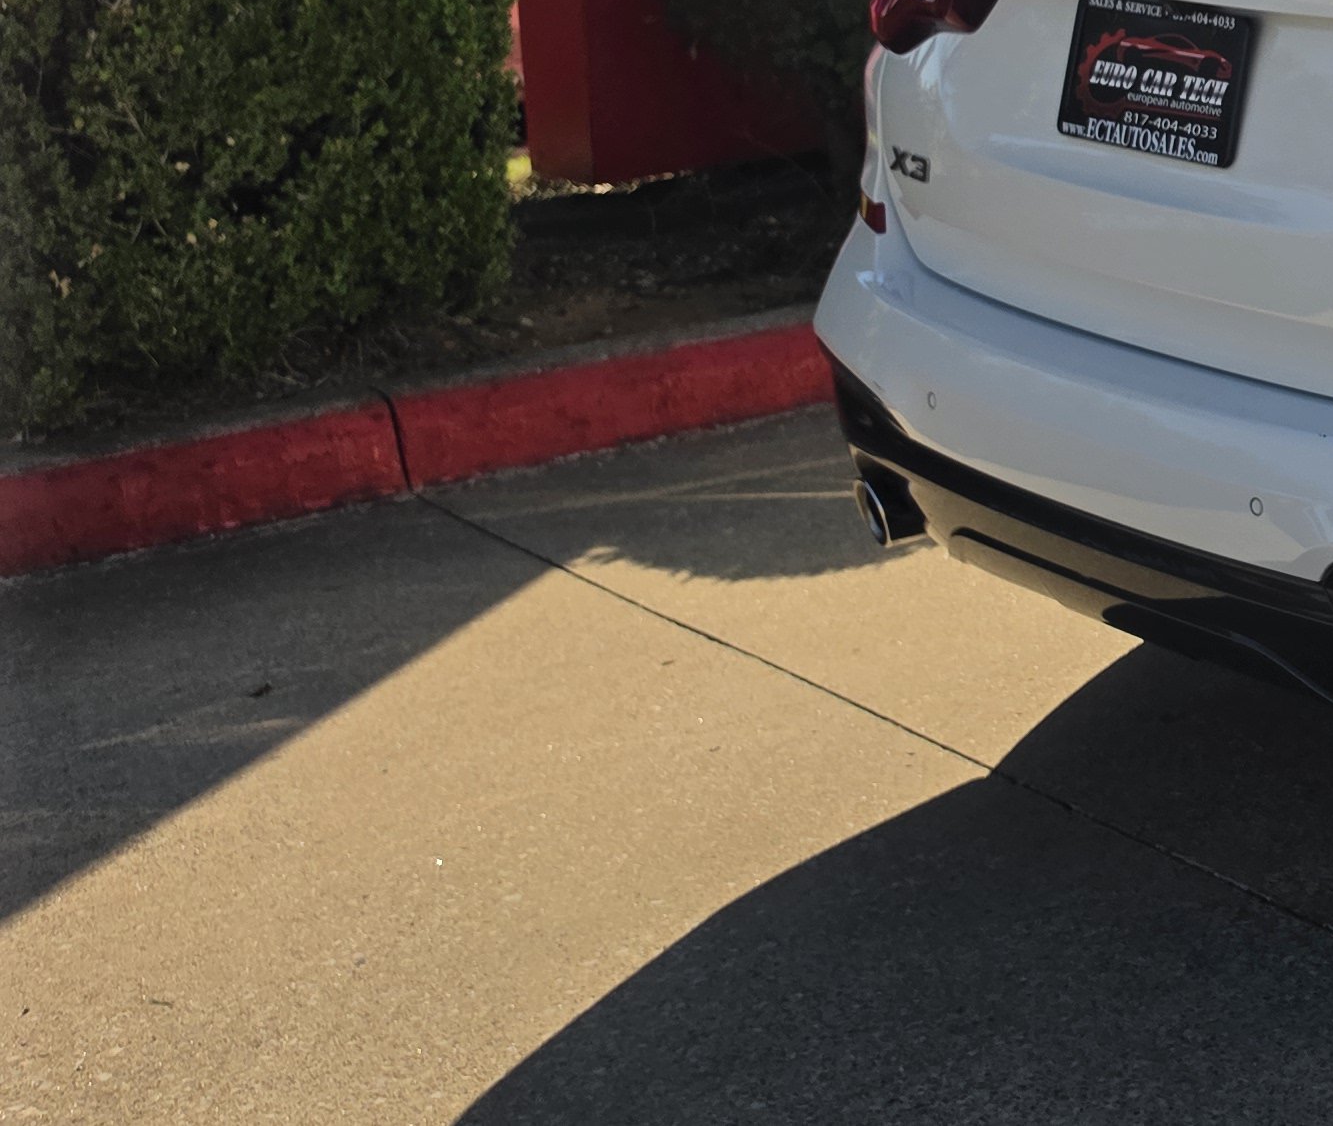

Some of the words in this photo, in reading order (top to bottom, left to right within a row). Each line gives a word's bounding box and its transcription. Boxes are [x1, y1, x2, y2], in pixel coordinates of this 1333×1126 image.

[1115, 0, 1123, 11] &
[1125, 1, 1162, 18] SERVICE
[1172, 11, 1236, 31] -404-4033
[1089, 59, 1138, 90] EURO
[1139, 68, 1178, 98] CAR
[1179, 75, 1230, 106] TECH
[1127, 92, 1169, 110] european
[1169, 97, 1223, 118] automotive
[1062, 117, 1219, 166] www.ECTAUTOSALES.com
[1123, 110, 1218, 140] 817-404-4033
[889, 145, 930, 183] X3
